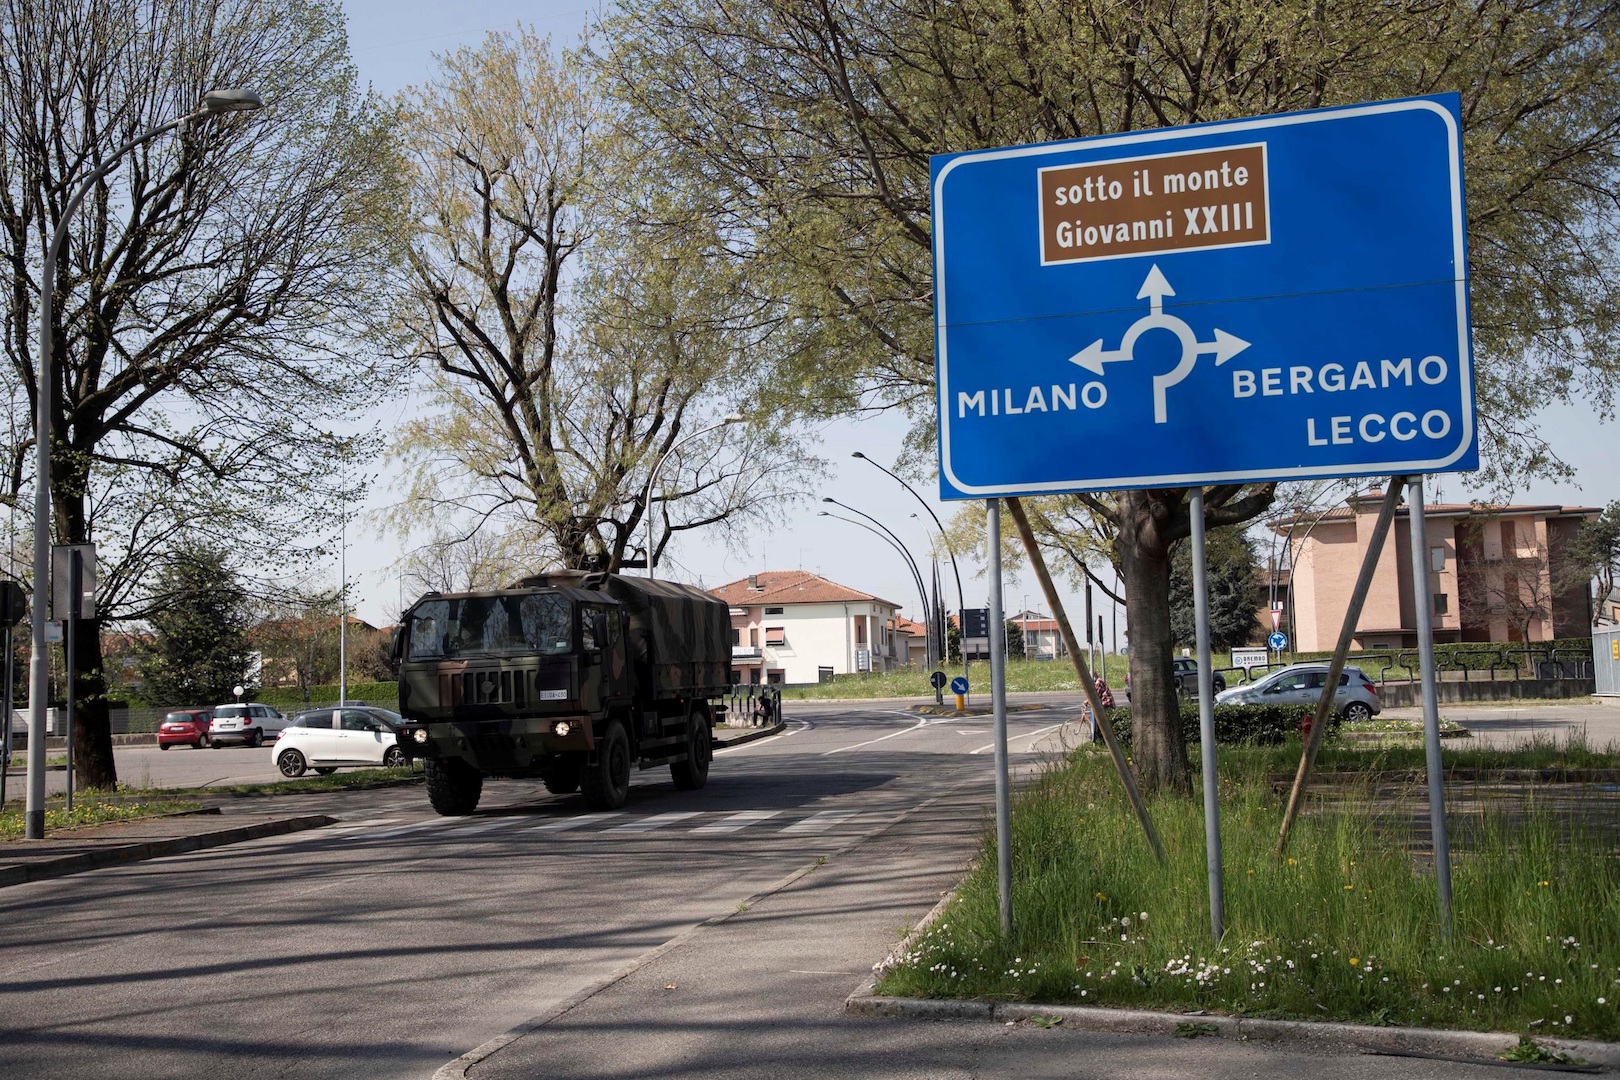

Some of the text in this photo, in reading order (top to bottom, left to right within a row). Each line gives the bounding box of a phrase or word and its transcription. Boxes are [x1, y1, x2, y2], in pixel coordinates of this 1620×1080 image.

[1055, 161, 1249, 206] sotto il monte
[1056, 202, 1253, 249] Giovanni XXIII
[1233, 355, 1449, 398] BERGAMO
[957, 381, 1108, 418] MILANO
[1307, 409, 1451, 446] LECCO
